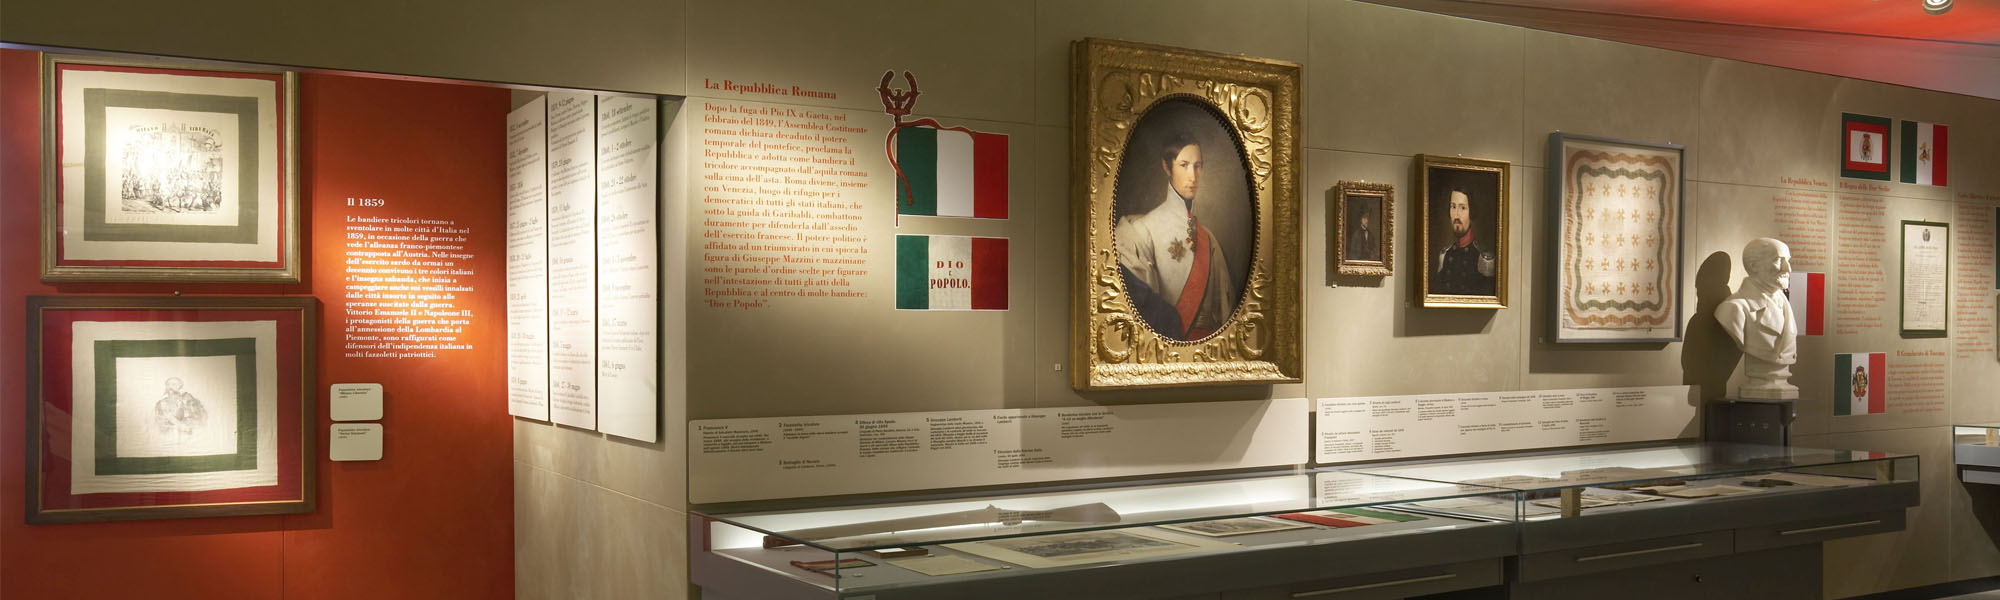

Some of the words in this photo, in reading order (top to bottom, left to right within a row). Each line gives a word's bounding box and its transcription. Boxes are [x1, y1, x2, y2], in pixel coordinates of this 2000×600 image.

[705, 78, 719, 90] La
[724, 80, 787, 98] Repubblica
[792, 85, 836, 99] Romana
[704, 102, 727, 115] Dopo
[729, 104, 736, 113] la
[739, 104, 757, 117] fuga
[759, 106, 767, 115] di
[770, 106, 784, 116] Pio
[786, 108, 796, 117] IX
[805, 109, 831, 120] Gaeta,
[834, 111, 846, 120] nel
[704, 113, 738, 124] febbraio
[740, 116, 752, 125] del
[778, 118, 823, 130] l'Assemblea
[825, 121, 867, 132] Costituente
[704, 127, 736, 136] romana
[738, 127, 773, 138] dichiara
[775, 129, 812, 140] decaduto
[822, 132, 847, 145] potere
[704, 136, 746, 150] temporale
[748, 139, 761, 148] del
[763, 140, 803, 153] pontefice,
[805, 142, 842, 155] proclama
[844, 144, 851, 153] la
[704, 148, 752, 162] Repubblica
[761, 151, 787, 161] adotta
[812, 154, 847, 164] bandiera
[704, 160, 738, 170] tricolore
[740, 161, 795, 175] accompagnato
[797, 164, 837, 177] dall'aquila
[704, 171, 723, 181] sulla
[724, 172, 744, 182] cima
[745, 173, 781, 183] dell'asta.
[784, 175, 806, 184] Roma
[808, 176, 838, 186] diviene,
[840, 177, 867, 187] insieme
[722, 183, 756, 194] Venezia,
[759, 185, 780, 197] luogo
[782, 186, 790, 195] di
[793, 186, 819, 198] rifugio
[821, 190, 836, 199] per
[347, 198, 354, 206] Il
[359, 198, 384, 207] 1859
[704, 194, 753, 205] democratici
[755, 196, 763, 205] di
[766, 196, 783, 206] tutti
[785, 197, 795, 209] gli
[797, 198, 814, 207] stati
[816, 198, 847, 209] italiani,
[849, 199, 862, 208] che
[704, 206, 724, 215] sotto
[726, 207, 734, 216] la
[736, 207, 759, 219] guida
[762, 208, 770, 217] di
[772, 208, 813, 219] Garibaldi,
[816, 209, 862, 220] combattono
[704, 218, 749, 227] duramente
[751, 221, 765, 230] per
[768, 219, 809, 229] difenderla
[811, 220, 857, 230] dall'assedio
[346, 232, 366, 240] 1859,
[704, 229, 754, 239] dell'esercito
[757, 230, 793, 240] francese.
[796, 231, 802, 240] Il
[805, 231, 830, 243] potere
[832, 232, 861, 244] politico
[704, 241, 736, 250] affidato
[738, 241, 748, 250] ad
[764, 242, 810, 251] triumvirato
[811, 242, 819, 251] in
[821, 243, 833, 252] cui
[835, 243, 858, 254] spicca
[860, 243, 867, 252] la
[704, 252, 729, 264] figura
[731, 253, 740, 262] di
[742, 253, 780, 265] Giuseppe
[783, 254, 813, 263] Mazzini
[822, 254, 864, 263] mazziniane
[936, 260, 964, 268] DIO
[725, 264, 732, 273] le
[734, 264, 760, 276] parole
[762, 264, 796, 273] d'ordine
[822, 268, 833, 276] per
[704, 276, 772, 285] nell'intestazione
[774, 276, 782, 285] di
[784, 276, 801, 285] tutti
[803, 276, 813, 288] gli
[815, 276, 828, 285] atti
[831, 276, 849, 285] della
[930, 278, 970, 289] POPOLO.
[704, 287, 751, 298] Repubblica
[760, 287, 767, 296] al
[769, 287, 795, 296] centro
[797, 287, 805, 296] di
[807, 287, 828, 296] molte
[704, 298, 724, 307] "Dio
[733, 298, 770, 310] Popolo".
[423, 309, 460, 318] Napoleone
[461, 309, 473, 317] III,
[398, 350, 436, 359] patriottici.
